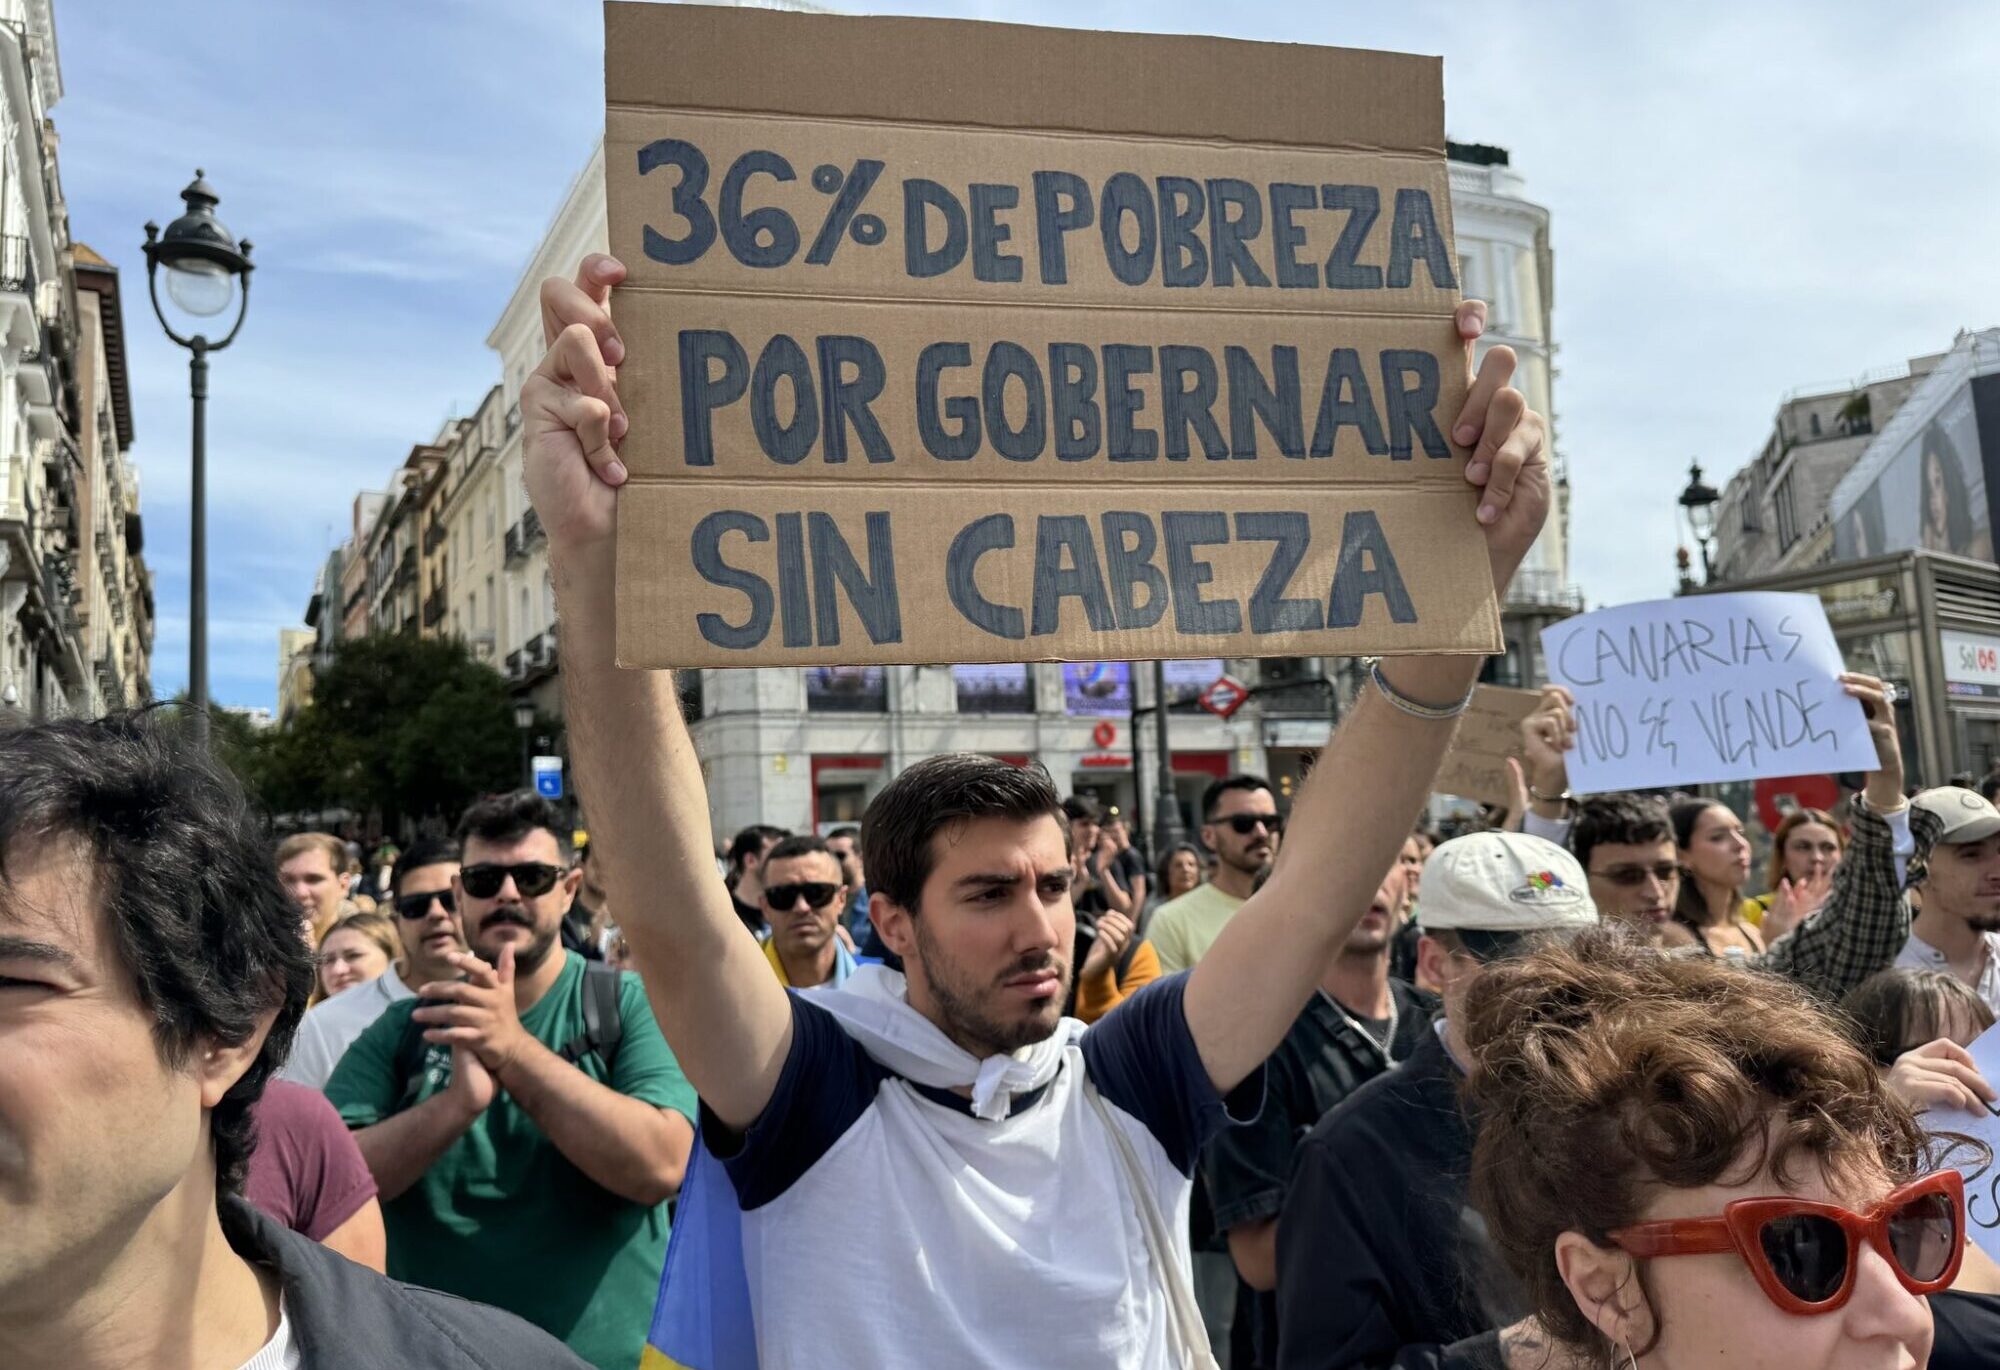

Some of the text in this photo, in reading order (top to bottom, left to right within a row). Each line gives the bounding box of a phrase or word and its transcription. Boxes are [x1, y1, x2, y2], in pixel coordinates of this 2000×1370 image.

[638, 139, 1458, 290] 36% DE POBREZA
[678, 329, 1452, 466] POR GOBERNAR
[691, 509, 1418, 650] SIN CABEZA
[1559, 615, 1802, 686] CANARIAS
[1575, 679, 1838, 768] NO SE VENDE
